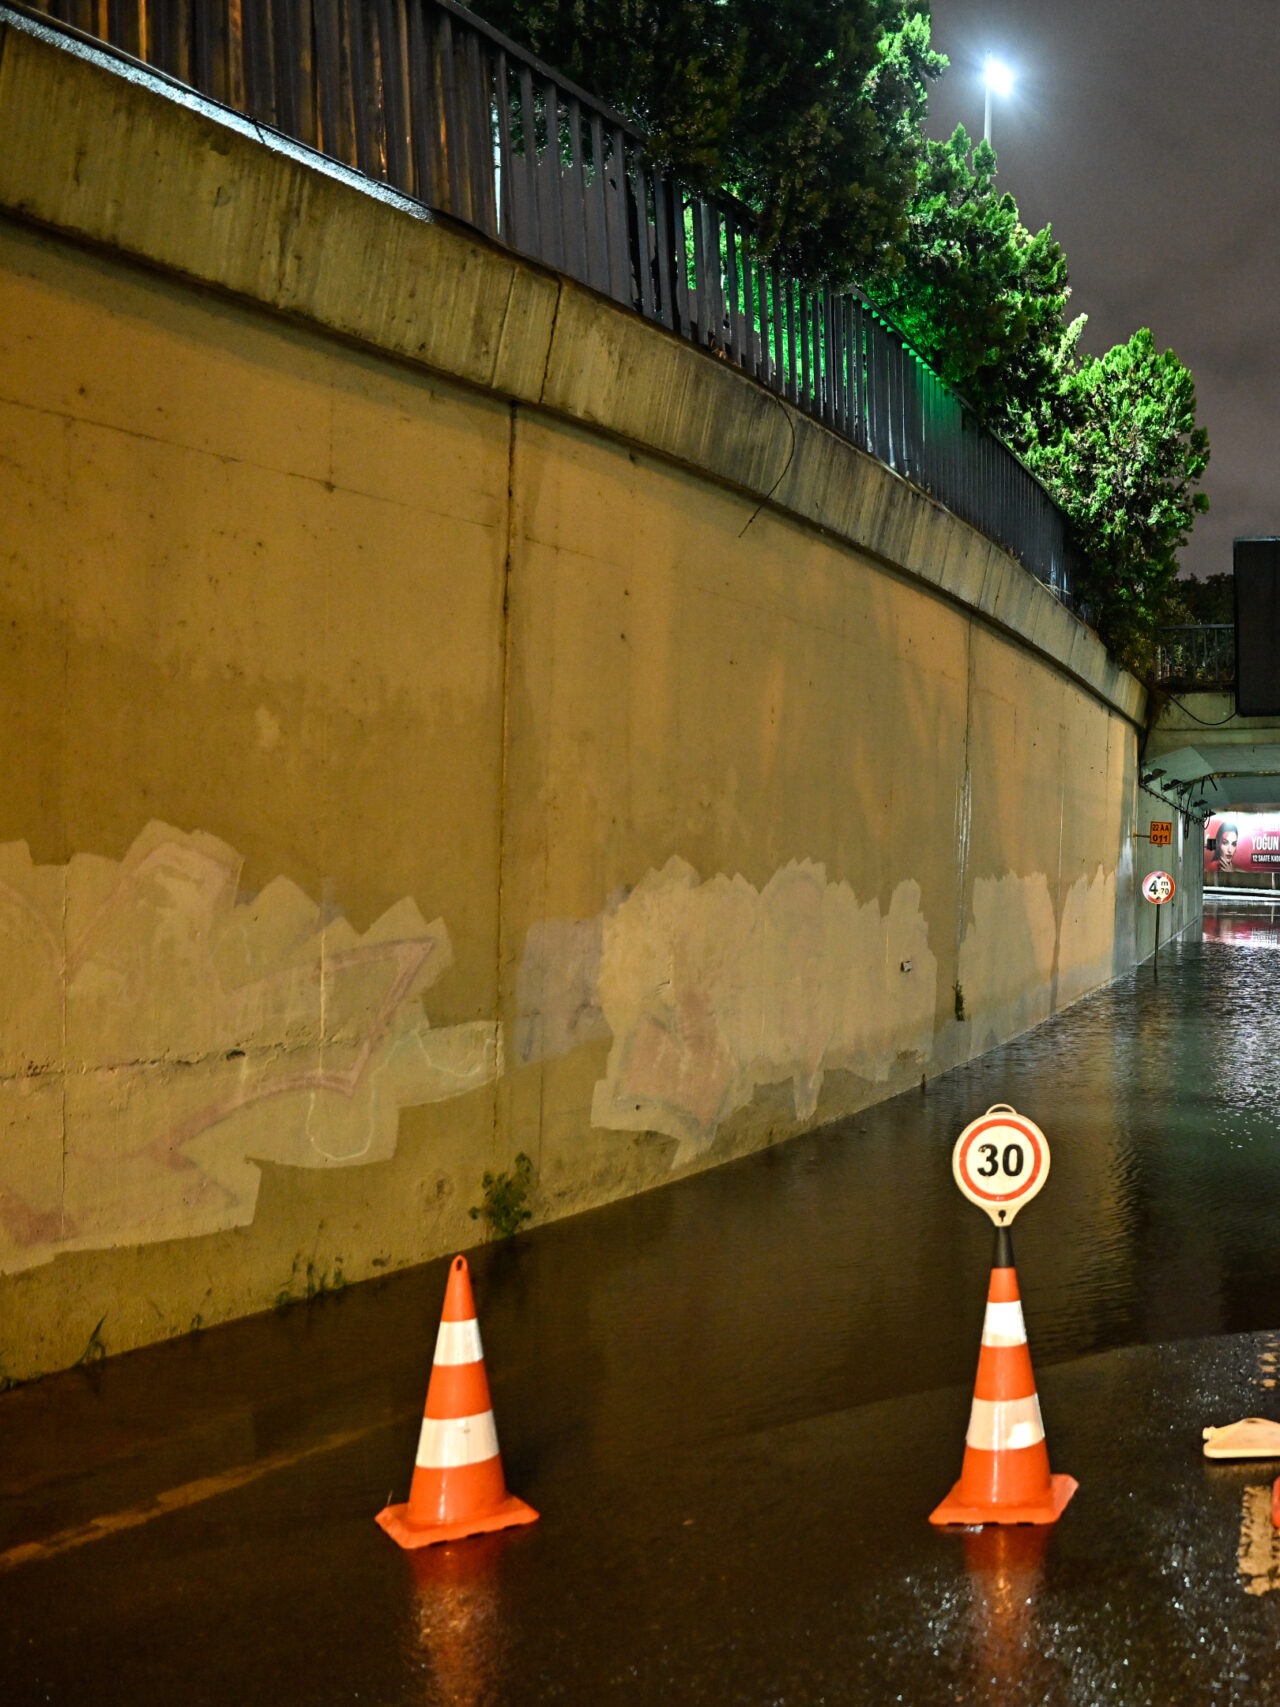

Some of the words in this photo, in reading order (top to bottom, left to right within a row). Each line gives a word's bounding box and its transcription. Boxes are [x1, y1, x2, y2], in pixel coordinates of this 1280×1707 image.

[1152, 823, 1159, 832] 22
[1160, 824, 1169, 832] AA
[1152, 834, 1169, 843] 011
[1251, 834, 1279, 851] YOĞUN
[1252, 854, 1258, 862] 12
[1149, 880, 1159, 895] 4
[977, 1143, 1025, 1178] 30
